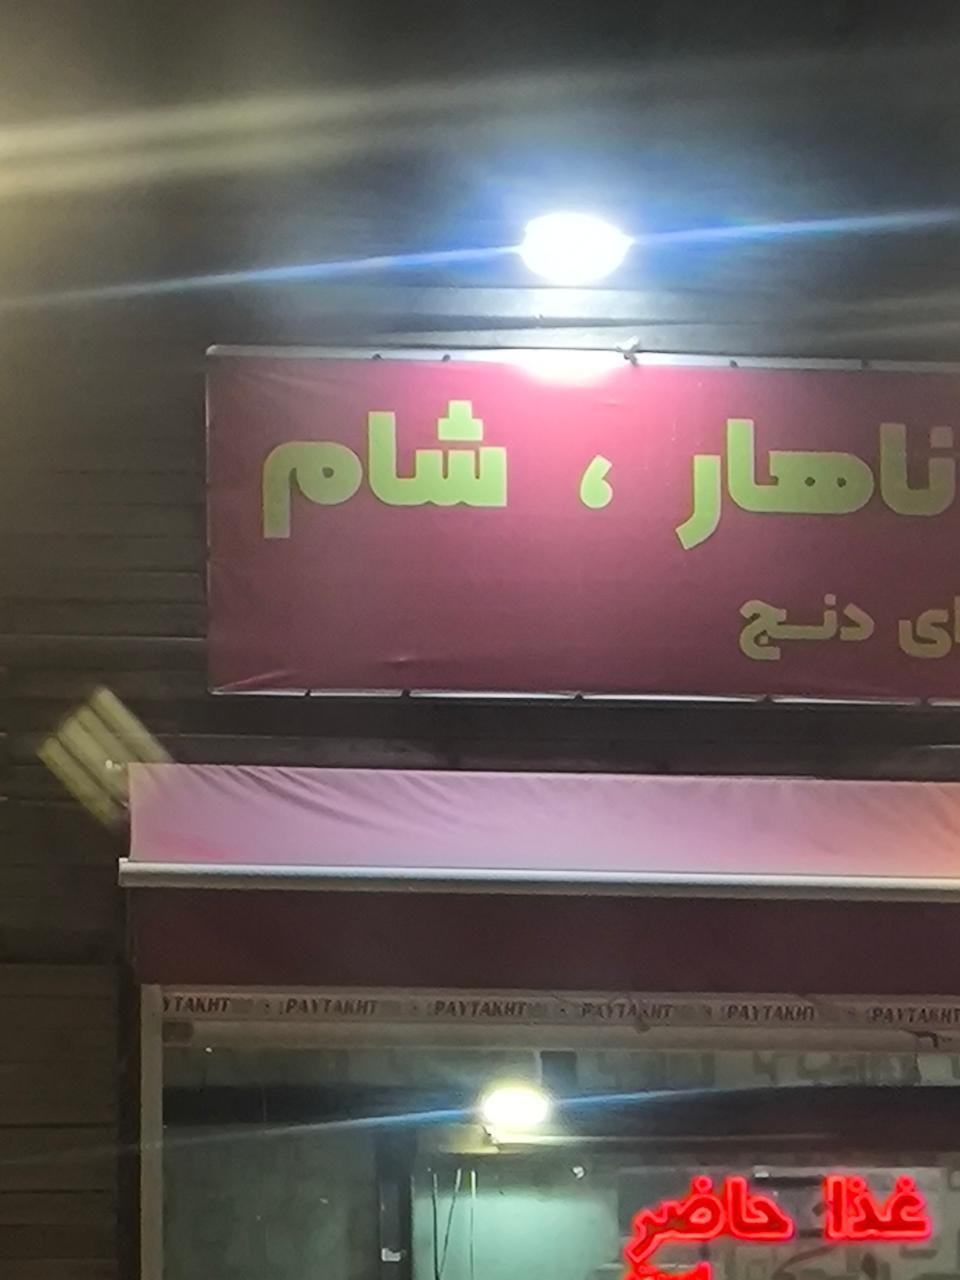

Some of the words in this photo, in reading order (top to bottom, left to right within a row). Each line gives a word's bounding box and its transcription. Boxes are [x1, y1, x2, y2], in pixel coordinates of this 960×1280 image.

[263, 400, 507, 538] شام
[675, 419, 957, 549] ناهار
[740, 593, 875, 661] دنج
[434, 1000, 527, 1017] PAYTAKHT
[625, 1175, 796, 1264] حاضر
[824, 1175, 933, 1241] غذا
